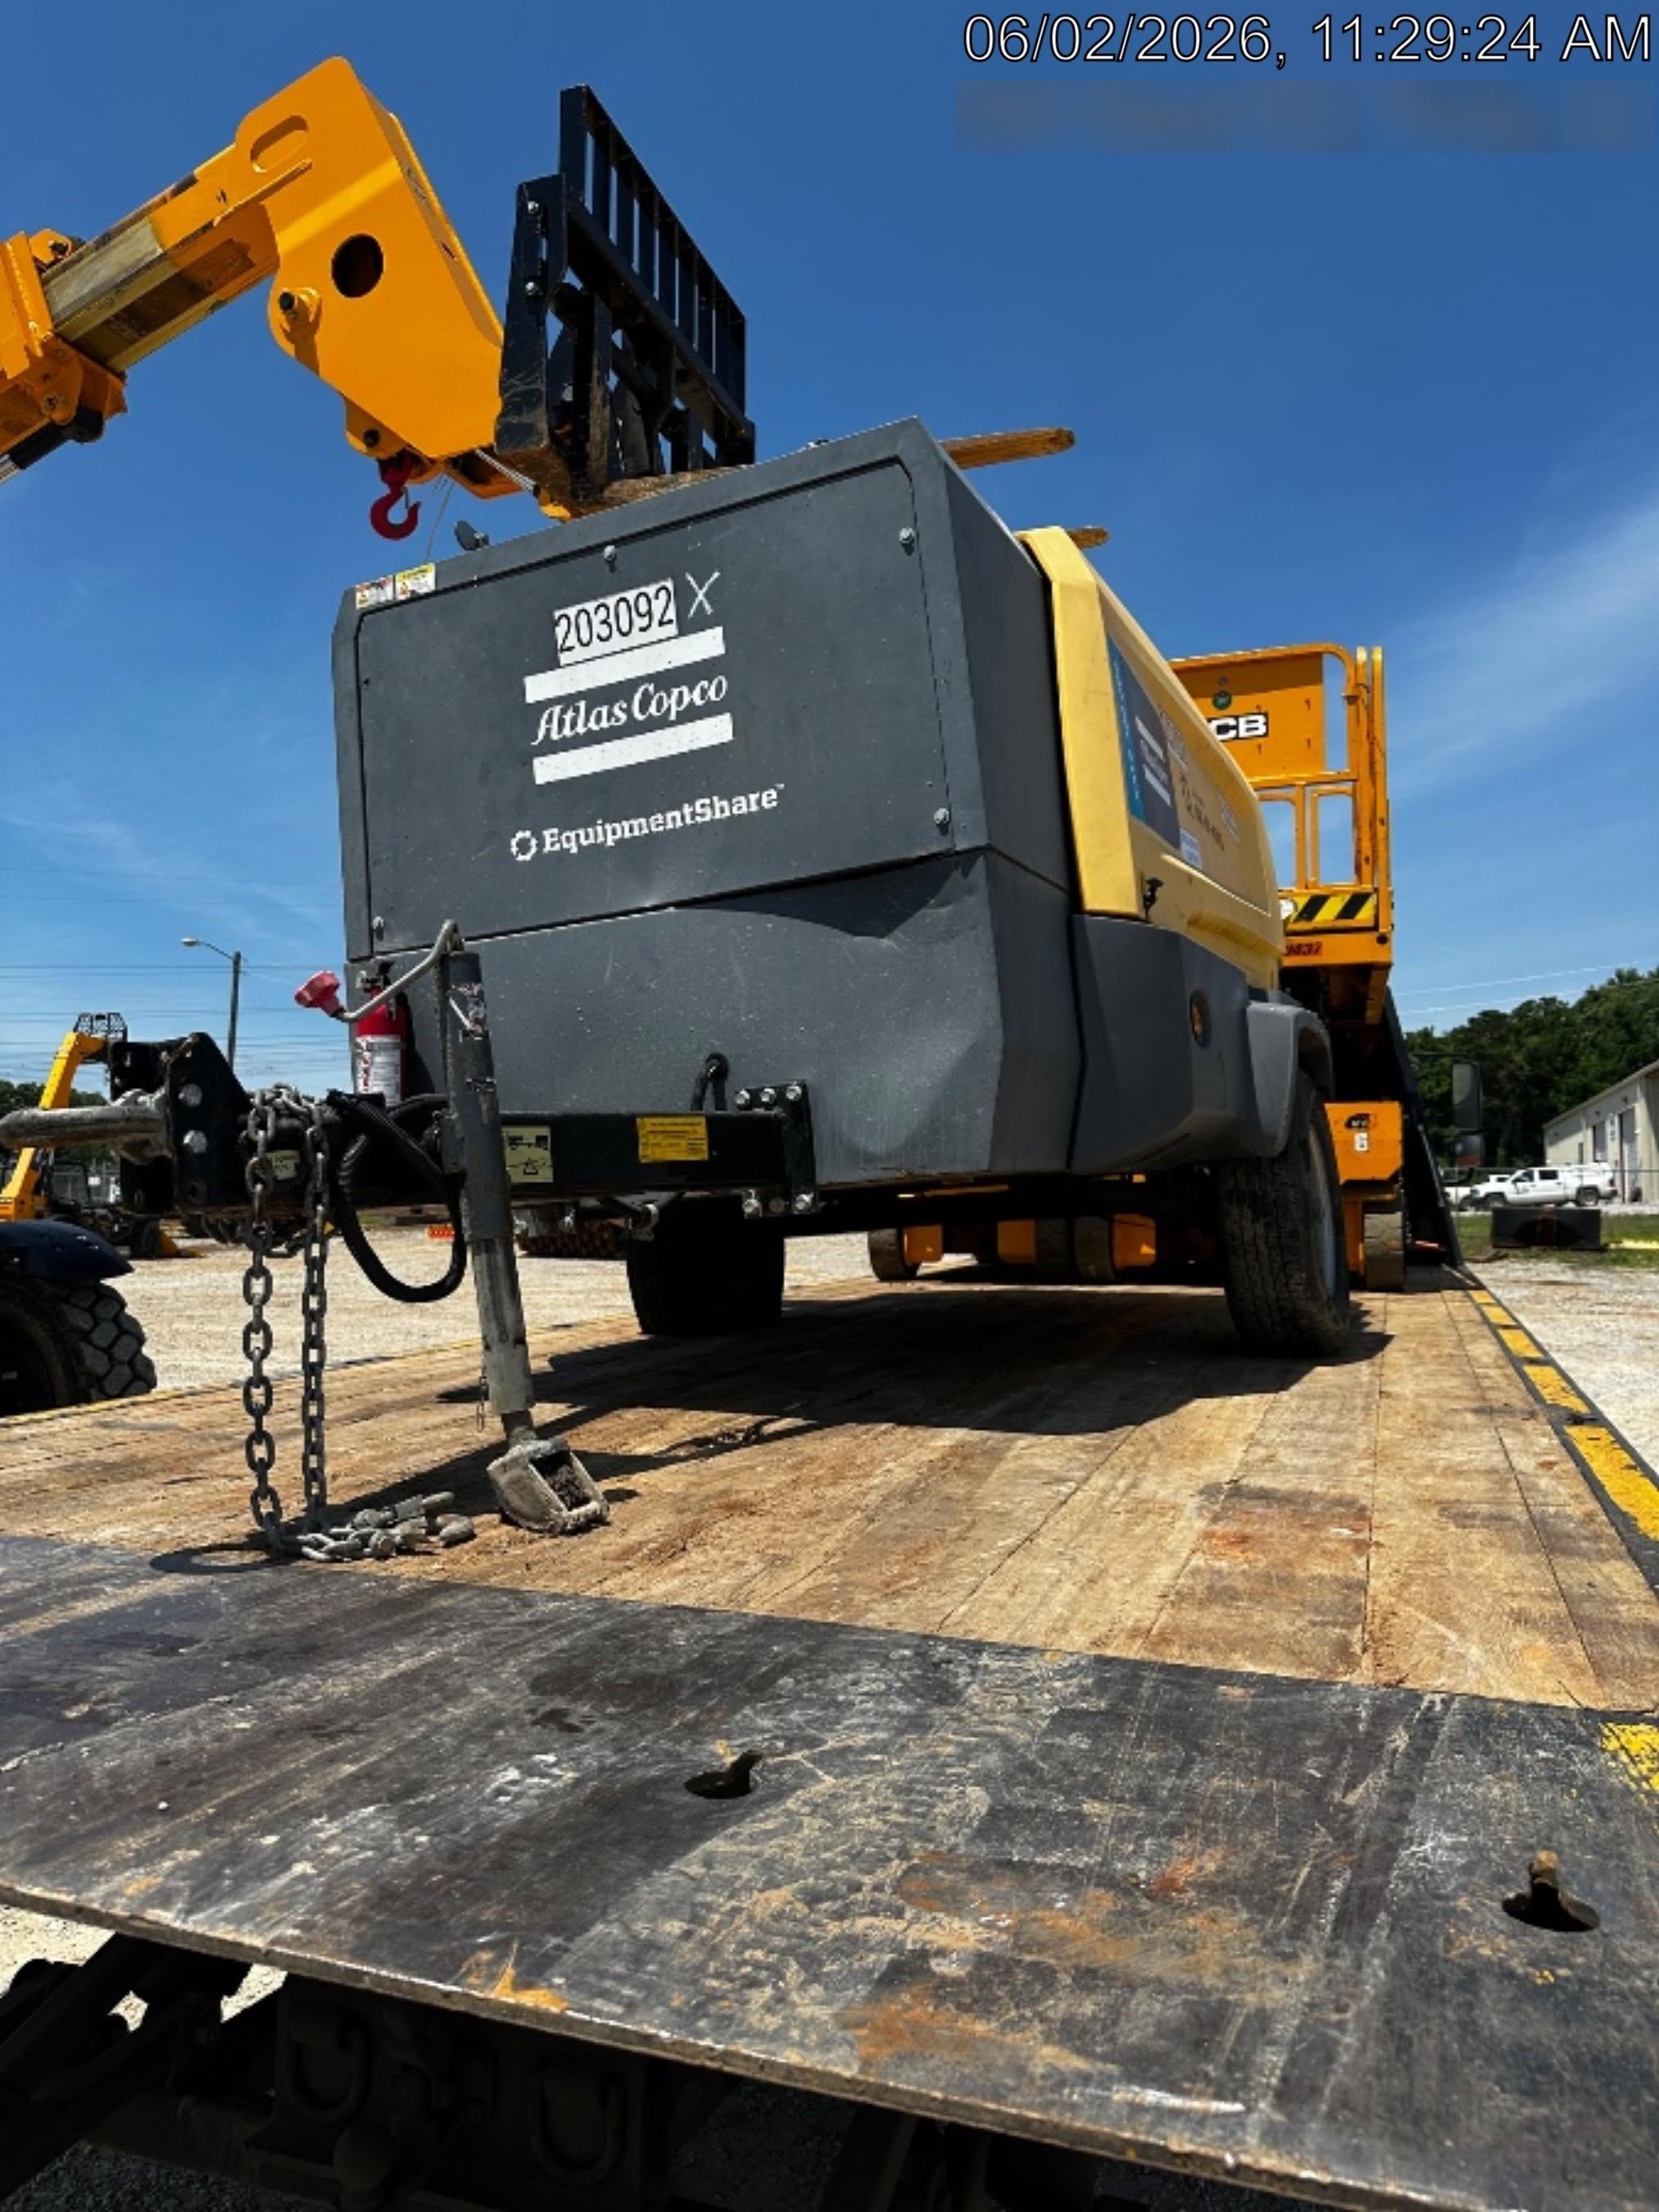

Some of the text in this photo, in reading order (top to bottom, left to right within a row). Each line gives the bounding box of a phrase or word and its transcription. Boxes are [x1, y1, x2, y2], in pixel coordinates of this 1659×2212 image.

[555, 584, 674, 653] 203092
[531, 675, 728, 746] Atlas Copco
[1208, 714, 1267, 740] CB
[542, 787, 779, 854] EquipmentShare
